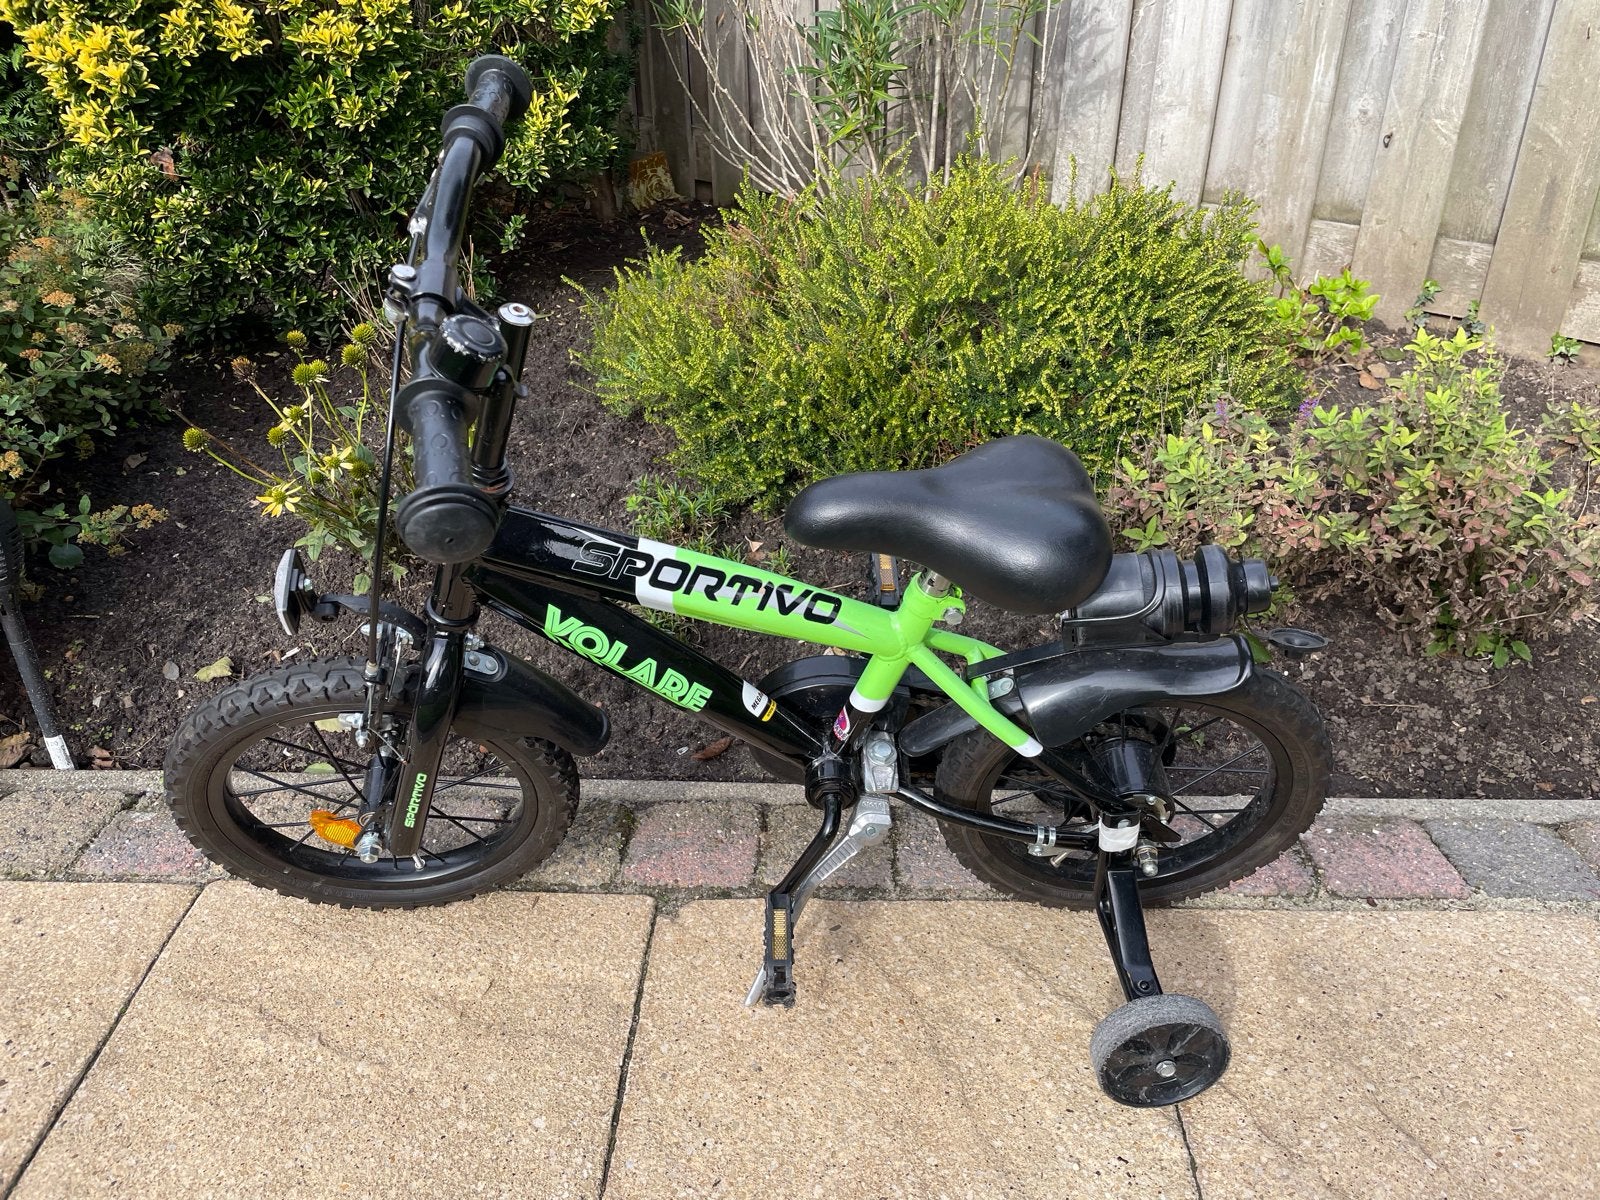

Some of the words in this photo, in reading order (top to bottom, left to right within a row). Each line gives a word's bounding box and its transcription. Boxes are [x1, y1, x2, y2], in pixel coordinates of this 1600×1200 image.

[571, 540, 842, 625] SPORTIVO
[544, 603, 713, 712] VOLARE
[404, 772, 427, 828] SPORTIVO
